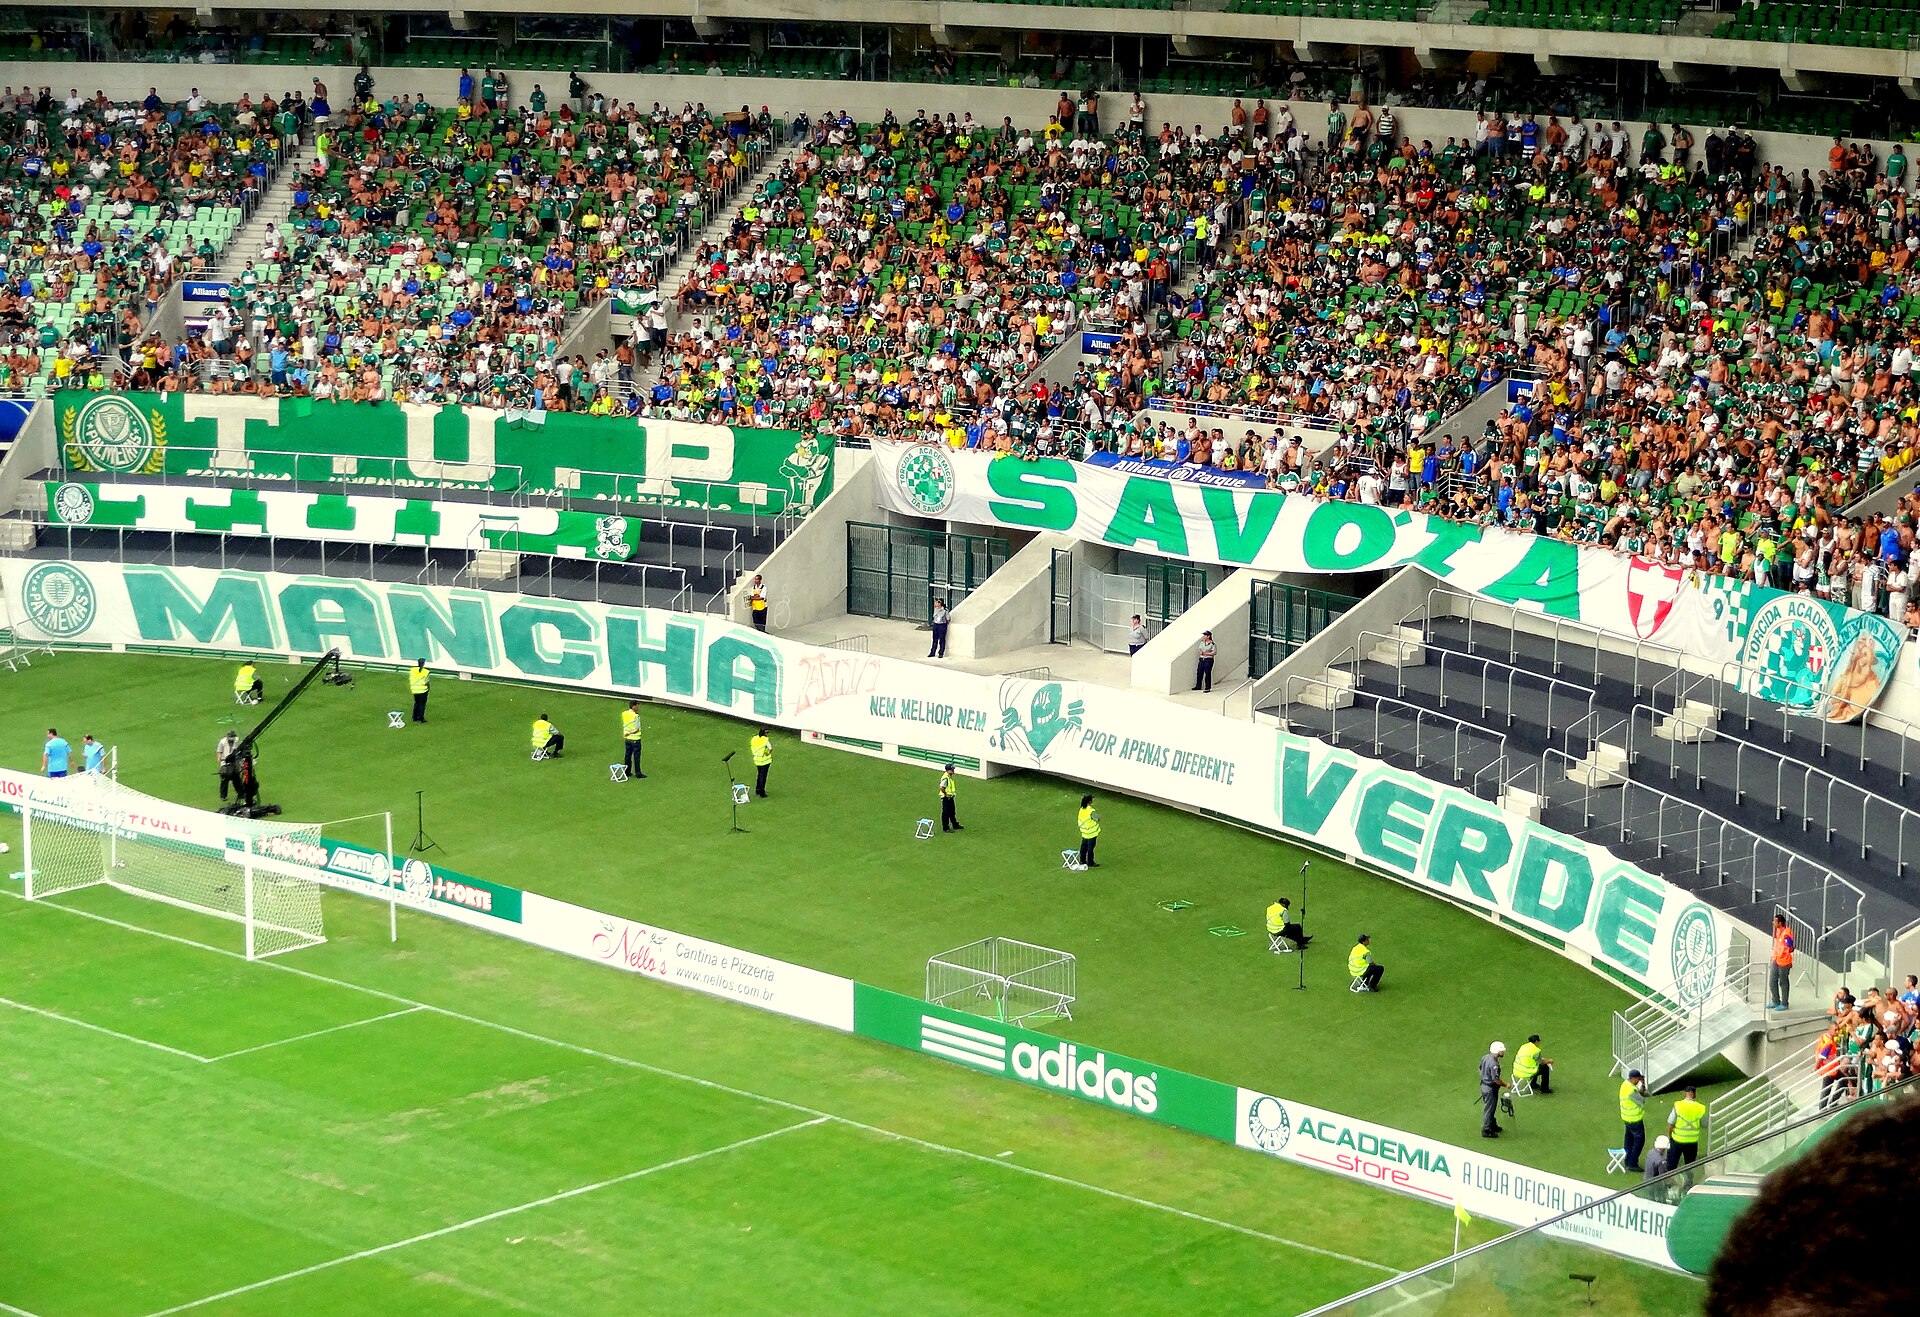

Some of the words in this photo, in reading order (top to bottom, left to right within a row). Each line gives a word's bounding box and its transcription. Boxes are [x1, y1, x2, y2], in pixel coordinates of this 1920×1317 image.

[192, 287, 218, 297] Allianz
[1090, 339, 1113, 349] Allian
[85, 429, 143, 467] PALMEIRAS
[1110, 459, 1171, 478] Allianz
[1190, 470, 1247, 488] Parque
[29, 592, 89, 632] PALMEIRAS
[122, 565, 784, 720] MANCHA
[1747, 605, 1782, 663] TORCIDA
[869, 695, 897, 719] NEM
[900, 698, 953, 727] MELHOR
[956, 707, 988, 733] NEM
[1079, 727, 1118, 756] PIOR
[1118, 737, 1171, 769] APENAS
[1170, 749, 1236, 786] DIFERENTE
[1274, 731, 1668, 978] VERDE
[675, 941, 719, 969] Cantina
[720, 956, 729, 969] e
[730, 956, 775, 983] Pizzeria
[675, 965, 776, 1002] www.nellos.com.br
[1011, 1041, 1158, 1114] adidas
[1296, 1116, 1452, 1178] ACADEMIA
[1335, 1153, 1411, 1187] store
[1462, 1161, 1472, 1185] A
[1476, 1165, 1510, 1197] LOJA
[1513, 1176, 1568, 1213] OFICIAL
